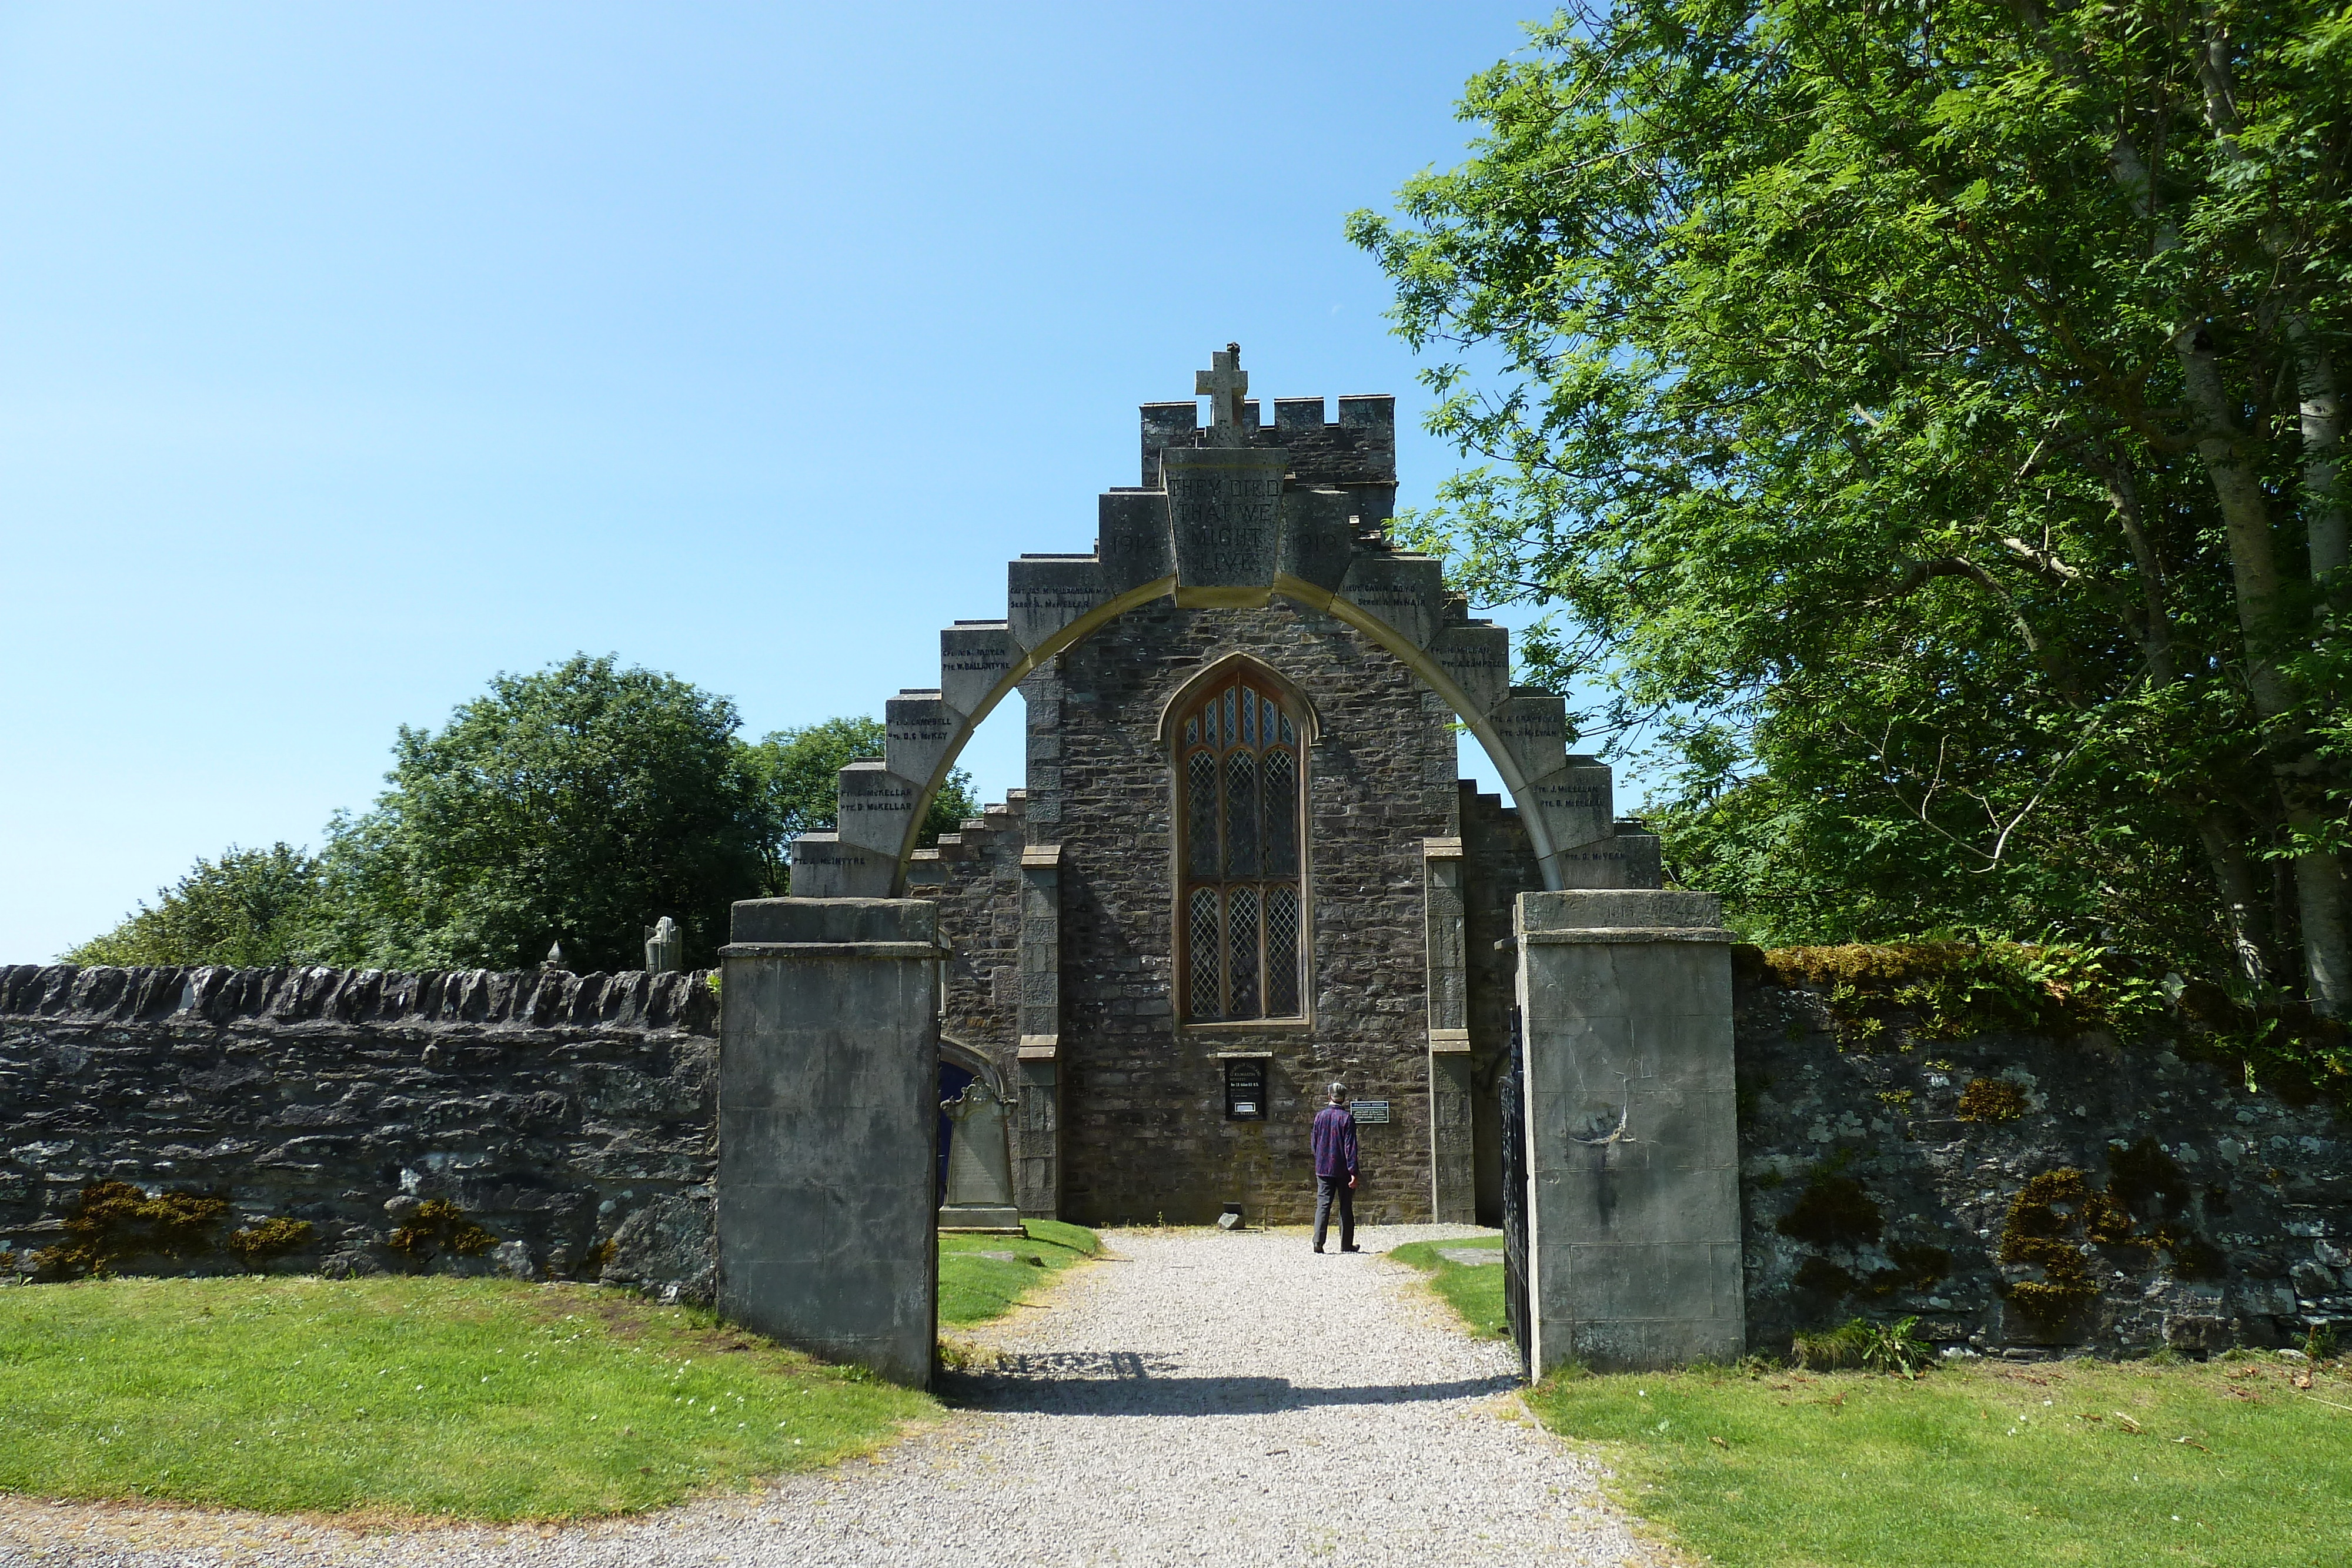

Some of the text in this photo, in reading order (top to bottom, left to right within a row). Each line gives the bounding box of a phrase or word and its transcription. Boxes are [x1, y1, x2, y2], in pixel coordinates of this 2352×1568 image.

[1169, 479, 1279, 497] THEY DIED
[1178, 504, 1272, 520] THAT WE
[1191, 529, 1262, 546] MIGHT
[1292, 534, 1337, 553] 1919
[1114, 536, 1159, 554] 1914
[1201, 553, 1255, 571] LIVE
[964, 661, 1011, 670] BALLANTYNE
[911, 718, 952, 726] CAMPBELL
[920, 731, 948, 740] McKAY
[867, 788, 912, 797] McKELLAR
[867, 803, 911, 811] McKELLAR
[820, 857, 866, 865] McINTYRE
